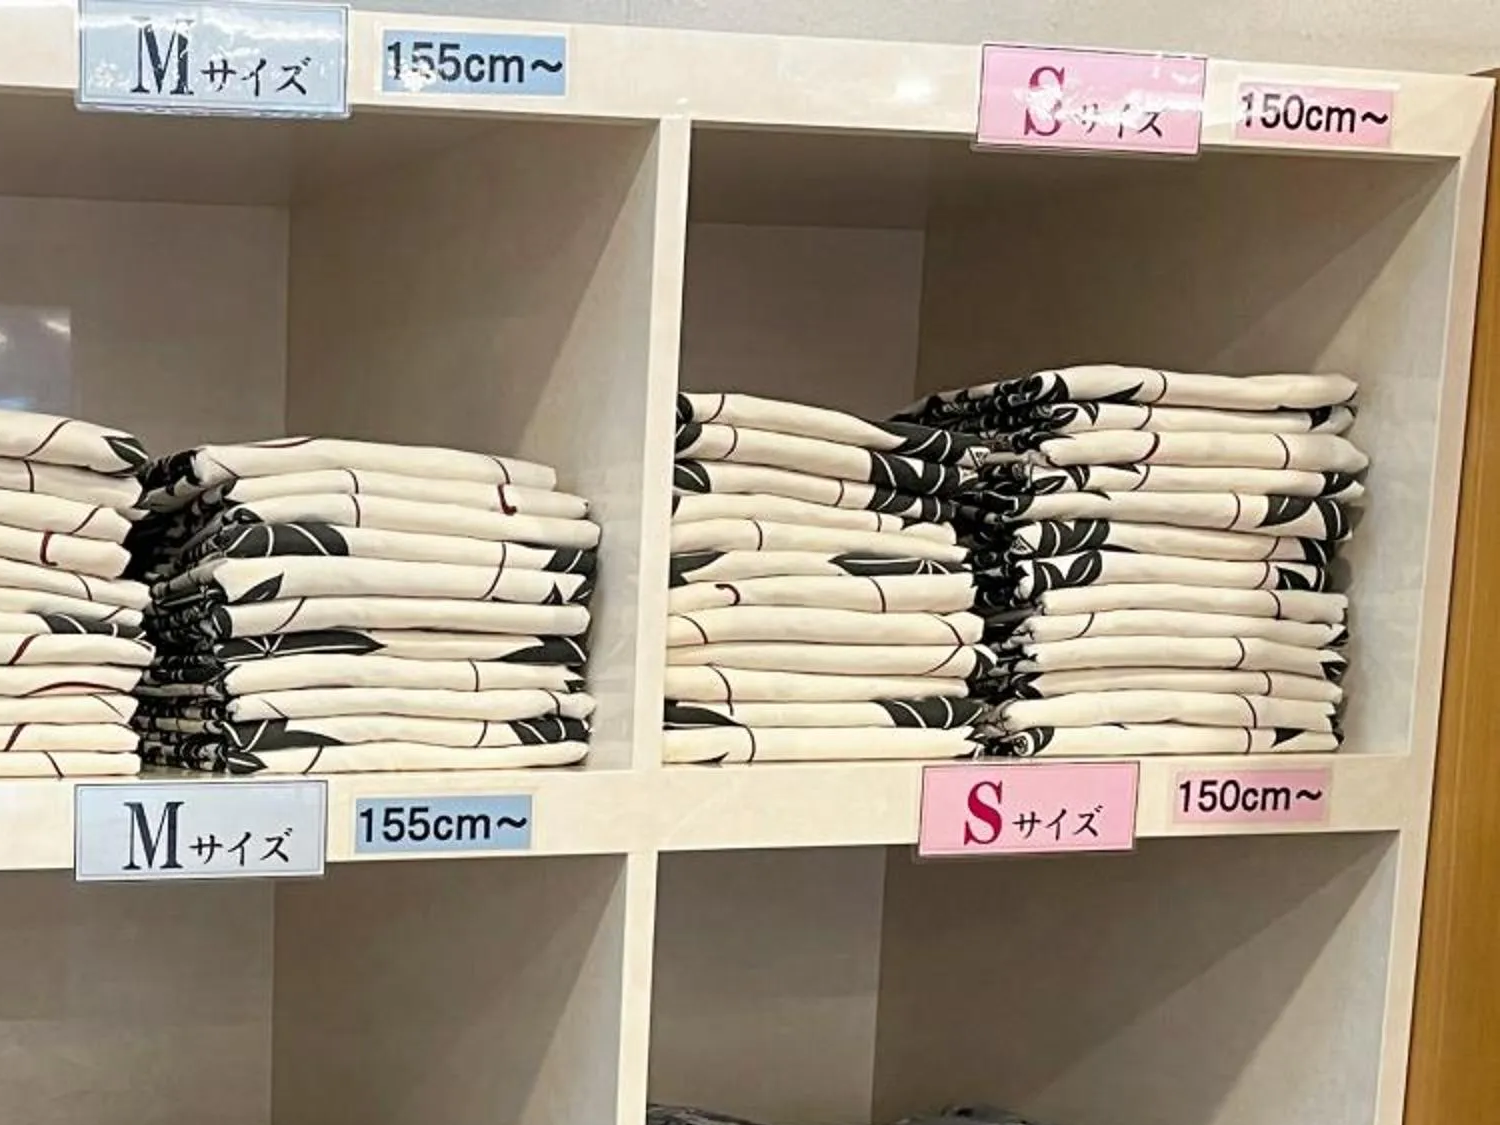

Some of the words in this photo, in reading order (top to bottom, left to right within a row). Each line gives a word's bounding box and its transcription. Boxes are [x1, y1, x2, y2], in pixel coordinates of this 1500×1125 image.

[131, 17, 313, 96] Mサイズ
[122, 801, 293, 870] Mサイズ
[963, 780, 1104, 845] Sサイズ
